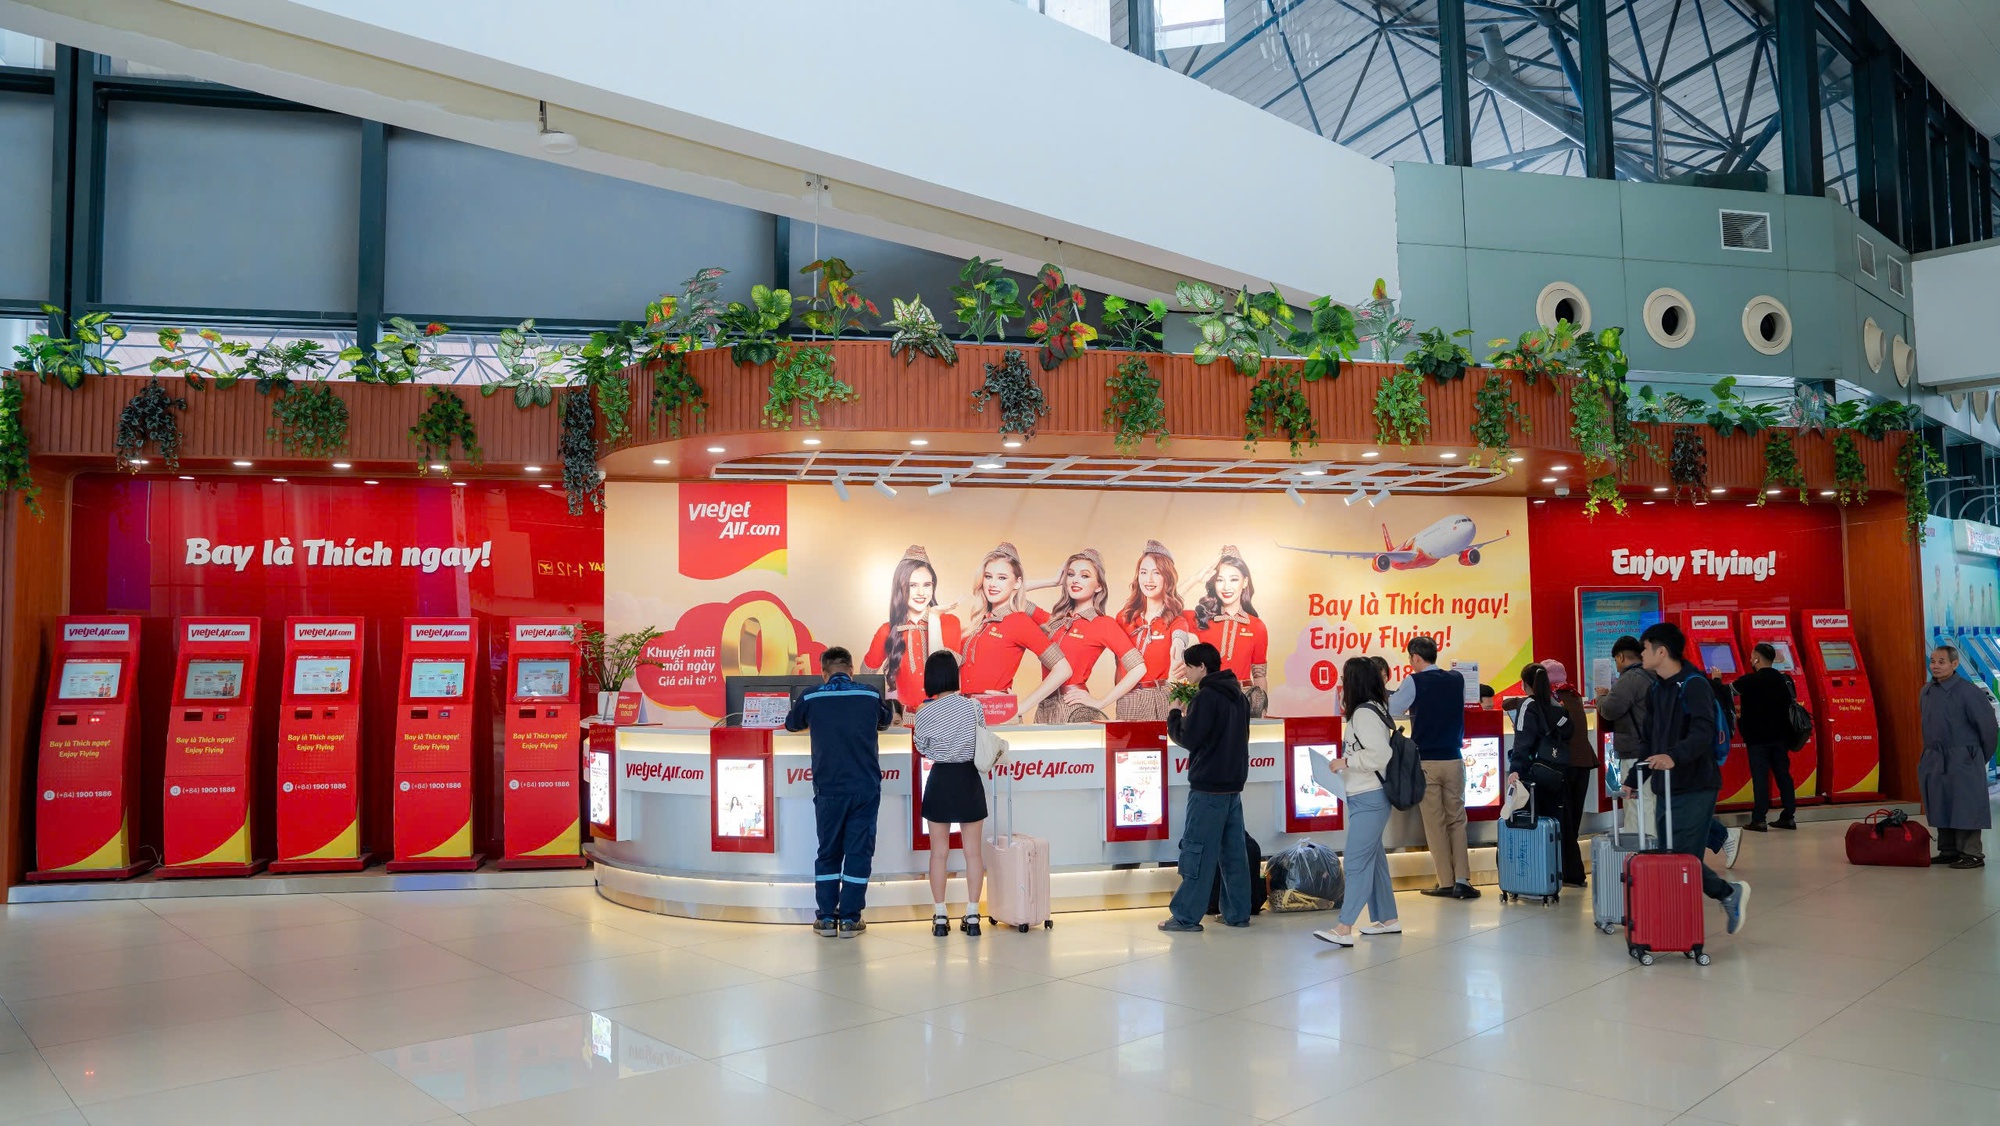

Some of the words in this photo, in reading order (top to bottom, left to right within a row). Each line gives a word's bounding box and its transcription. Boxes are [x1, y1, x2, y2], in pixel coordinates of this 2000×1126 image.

[719, 521, 781, 539] Air.com
[185, 537, 255, 573] Bay
[262, 537, 295, 566] là
[302, 538, 393, 567] Thích
[400, 540, 492, 573] ngay!
[1612, 548, 1686, 582] Enjoy
[1690, 549, 1777, 582] Flying!
[1309, 594, 1353, 621] Bay
[1360, 592, 1379, 616] là
[1386, 592, 1444, 615] Thích
[1452, 593, 1509, 620] ngay!
[1310, 625, 1372, 655] Enjoy
[647, 644, 691, 660] Khuyến
[694, 647, 715, 658] mãi
[662, 658, 684, 671] mỗi
[687, 661, 715, 674] ngày
[658, 675, 676, 687] Giá
[678, 675, 693, 686] chỉ
[92, 740, 111, 748] ngay!
[288, 734, 300, 742] Bay
[297, 744, 315, 752] Enjoy
[316, 744, 335, 752] Flying
